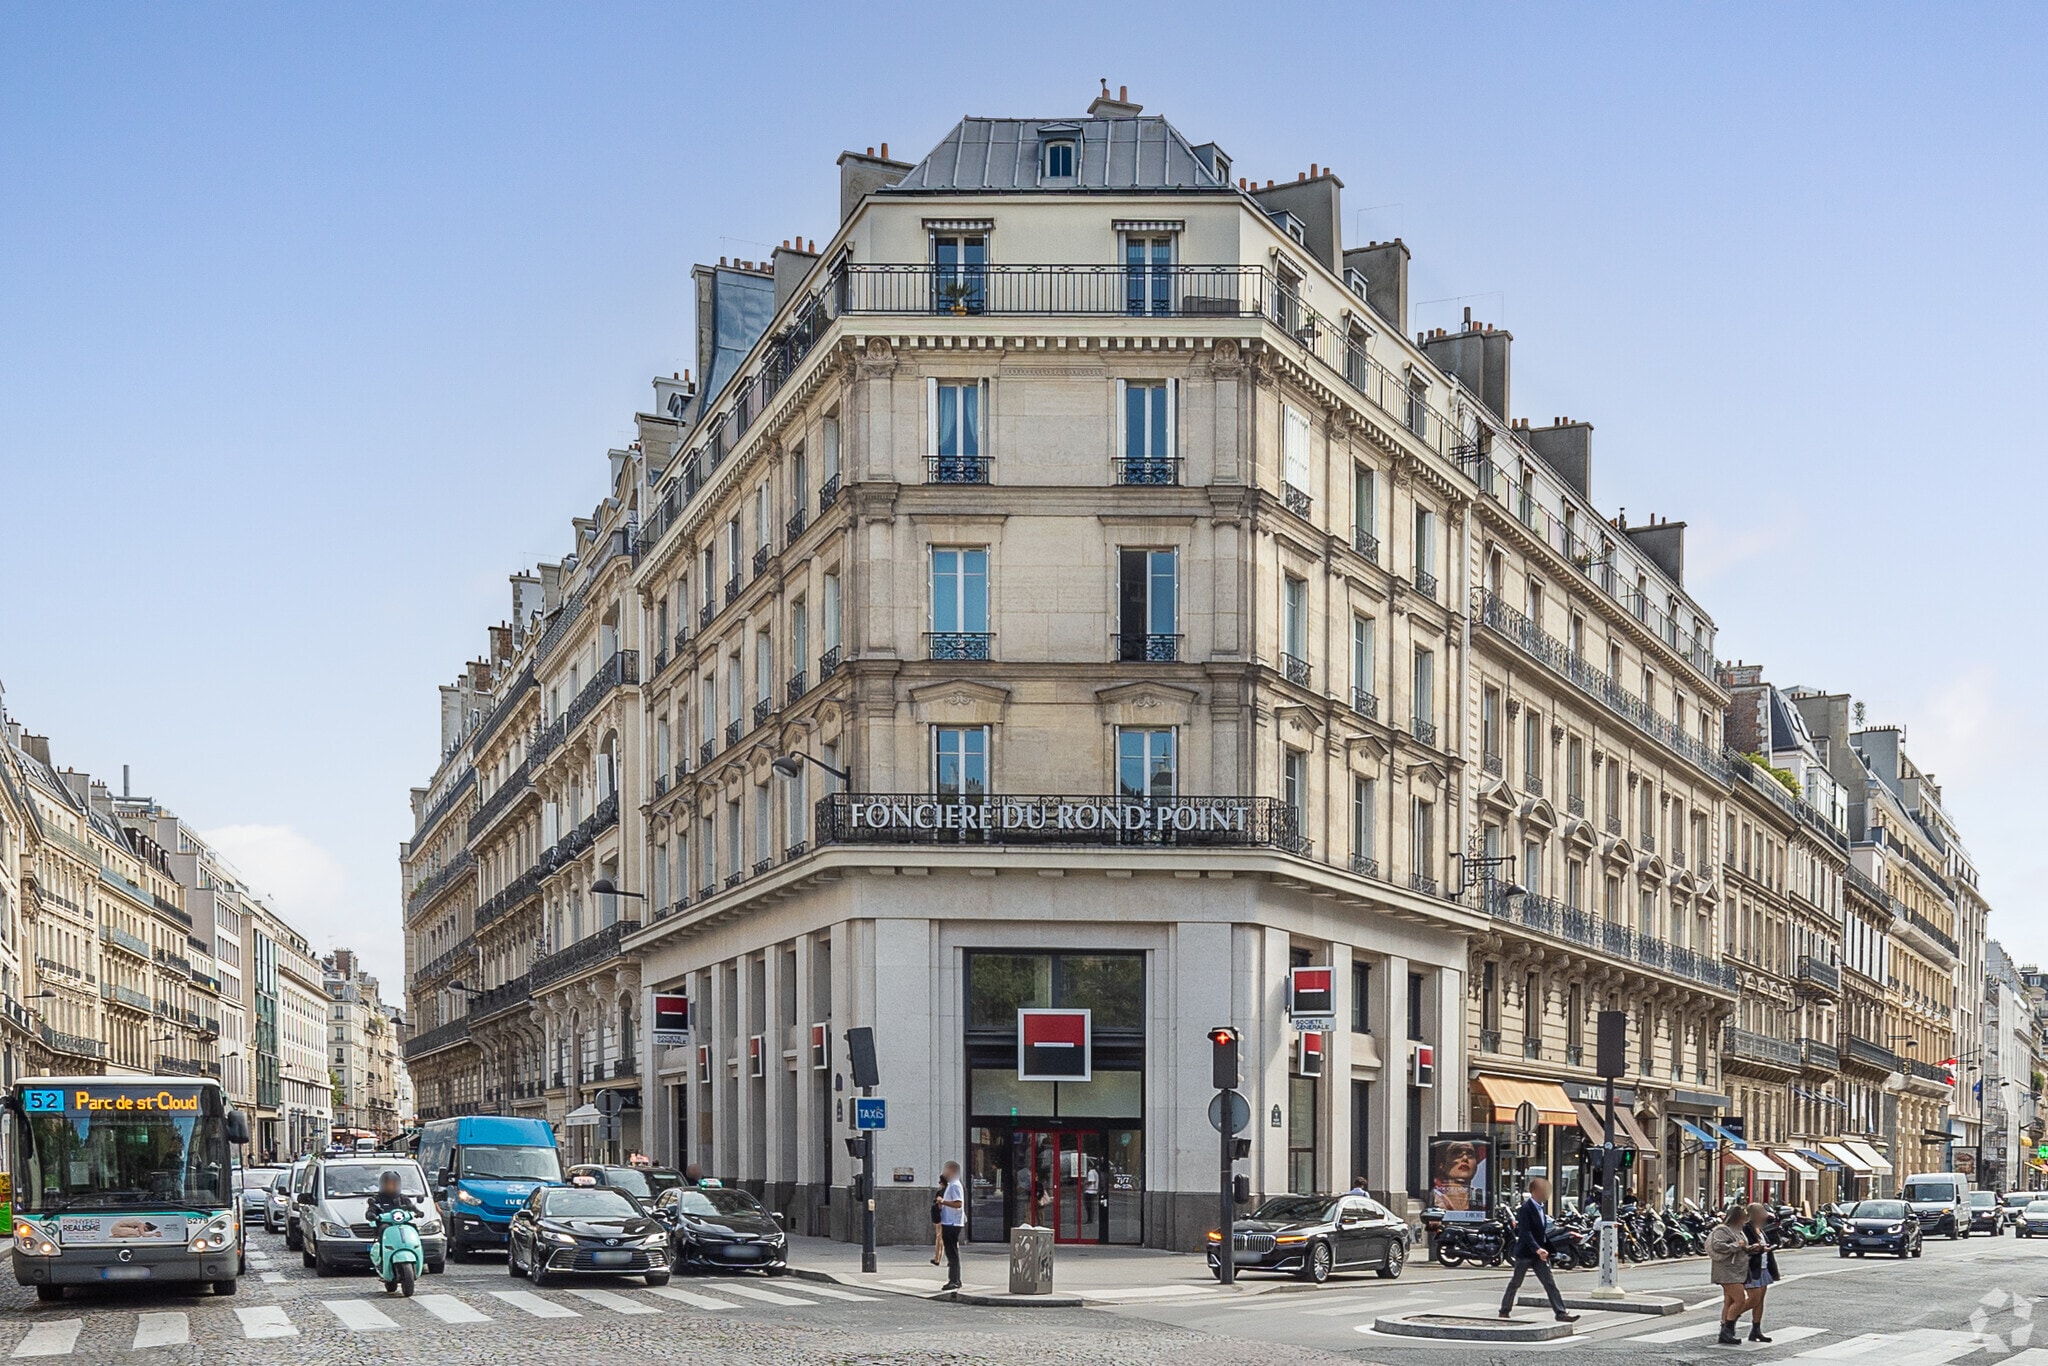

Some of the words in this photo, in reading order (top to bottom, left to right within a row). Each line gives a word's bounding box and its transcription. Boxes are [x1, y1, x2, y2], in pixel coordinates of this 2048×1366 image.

[851, 803, 992, 829] FONCIERE
[1002, 803, 1046, 830] DU
[1058, 804, 1146, 830] ROND
[1156, 805, 1249, 831] POINT
[31, 1092, 58, 1109] 52
[75, 1091, 113, 1110] Parc
[115, 1094, 133, 1110] de
[859, 1109, 884, 1119] TAXIS
